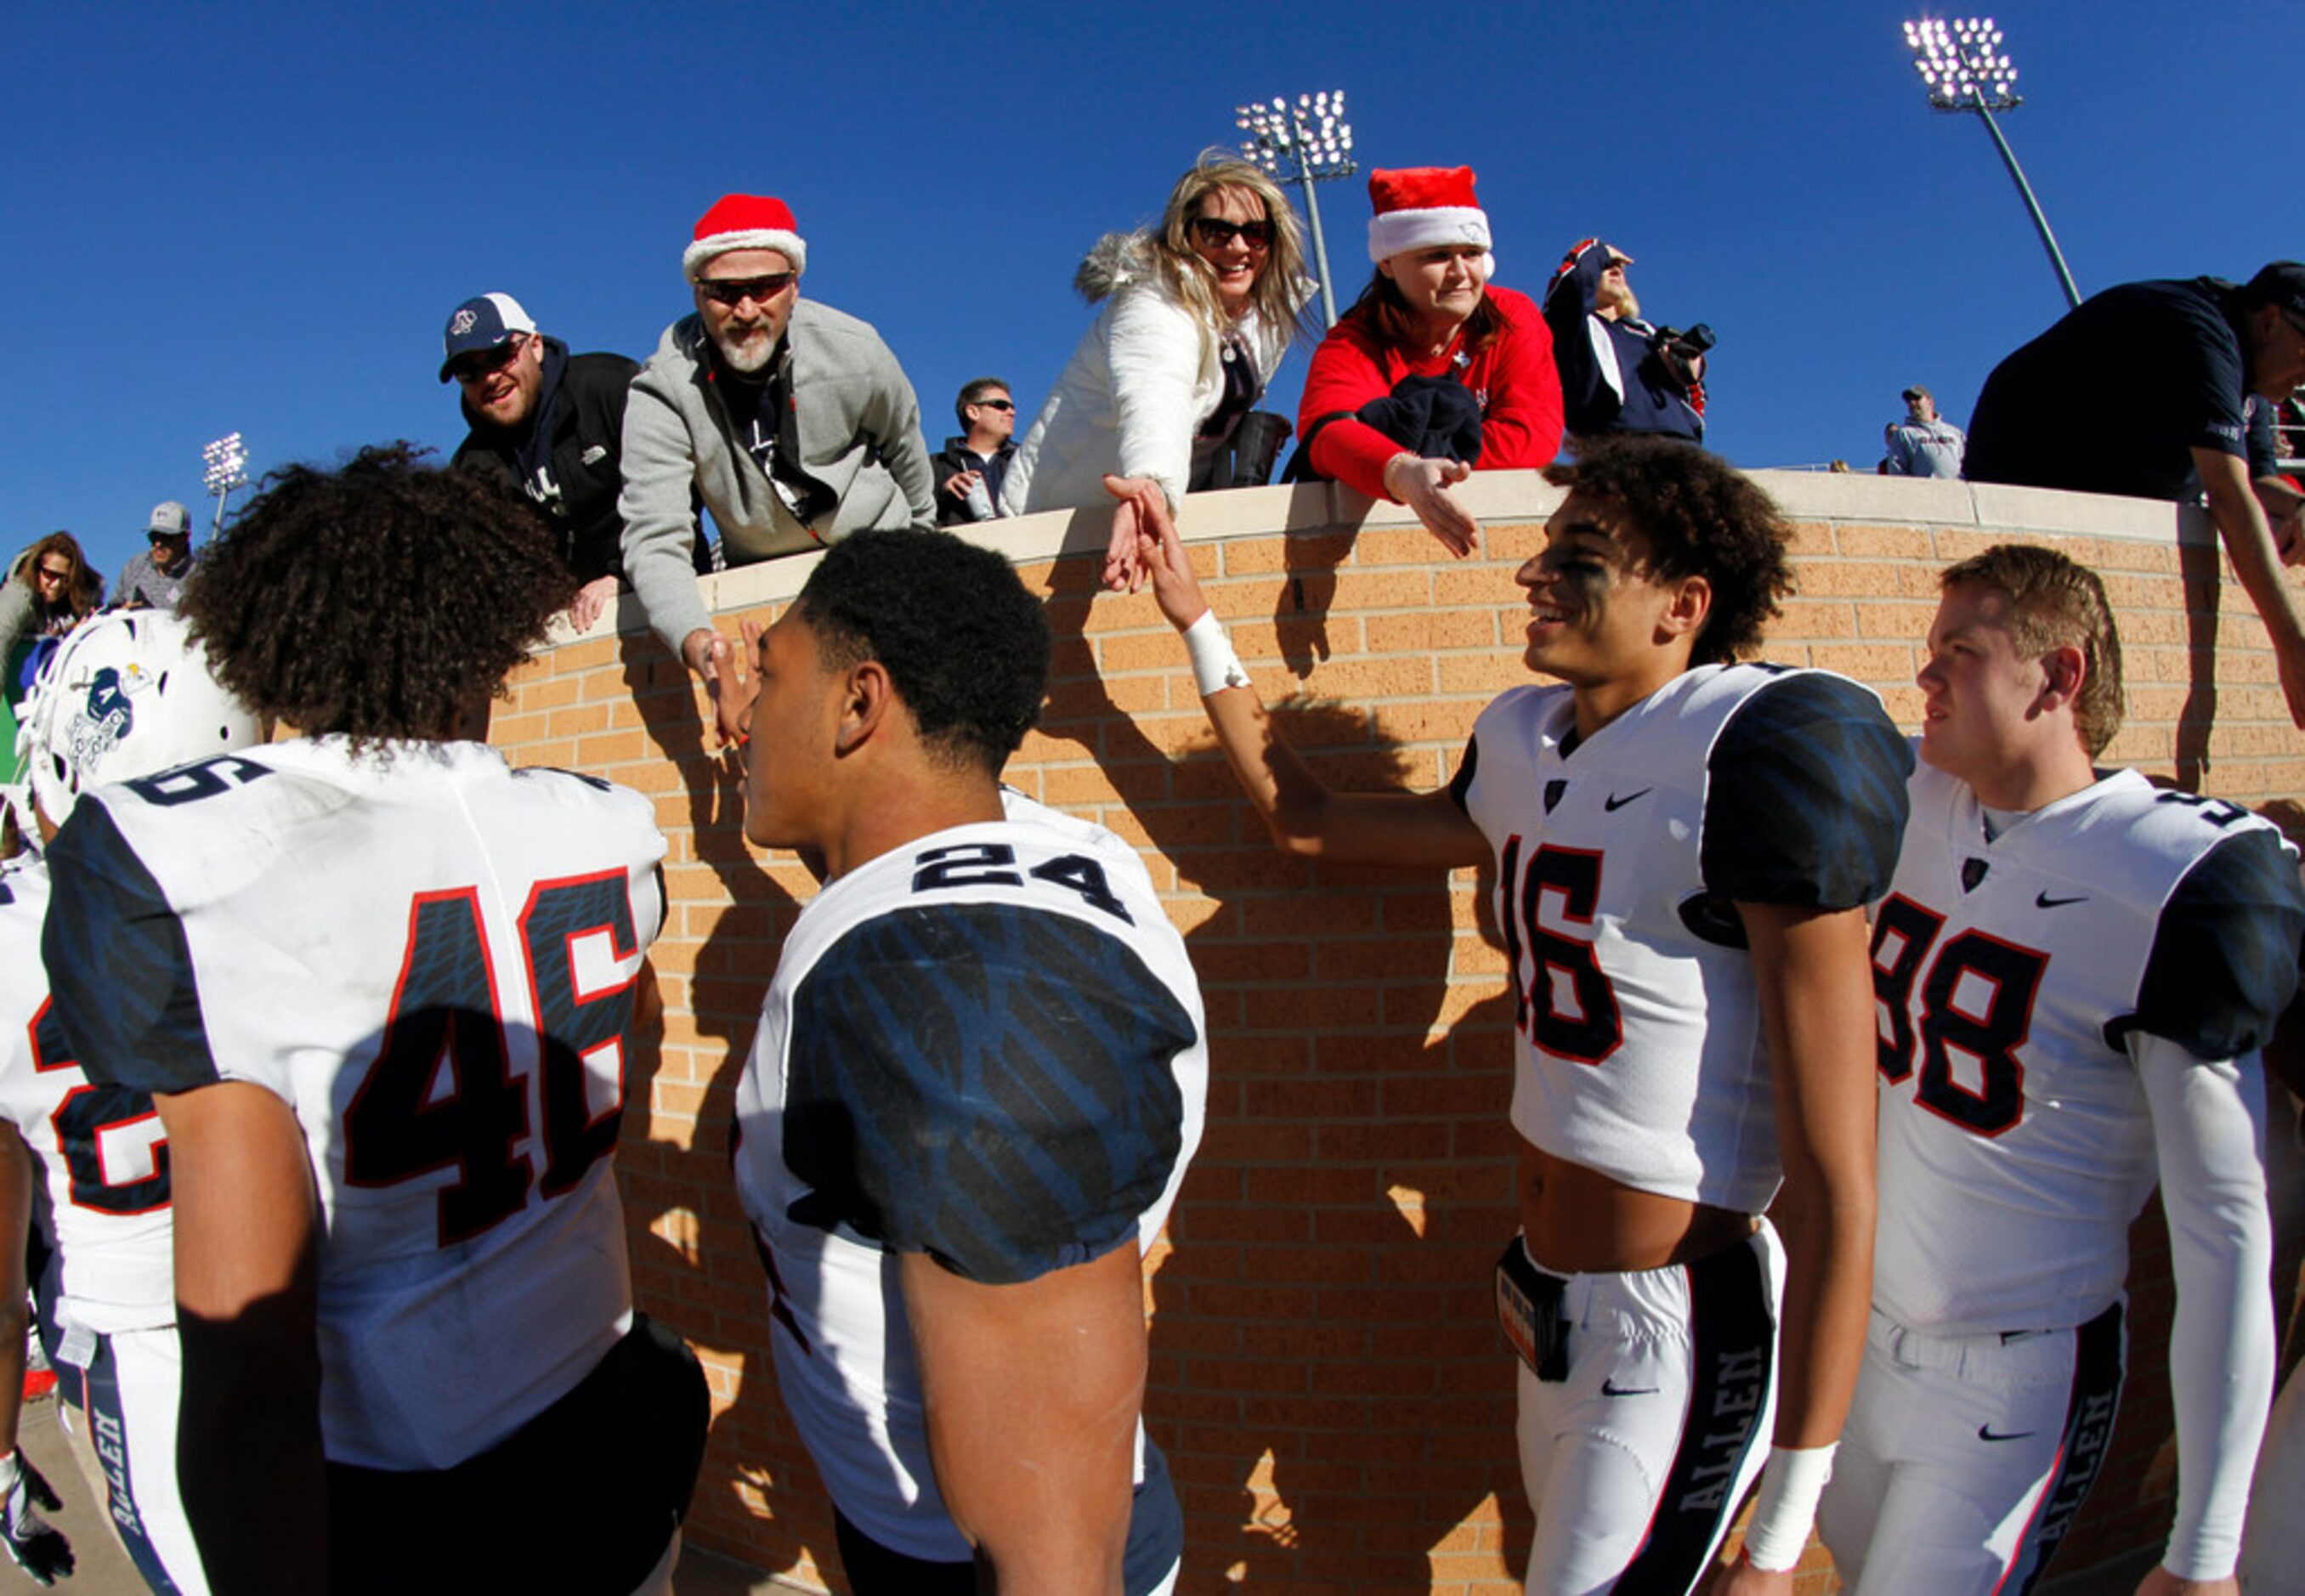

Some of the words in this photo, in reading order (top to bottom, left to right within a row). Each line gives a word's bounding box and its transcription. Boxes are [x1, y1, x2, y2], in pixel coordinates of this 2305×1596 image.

[911, 844, 1136, 928] 24
[343, 865, 639, 1249] 46
[93, 1406, 141, 1537] ALLEN
[1679, 1344, 1763, 1513] ALLEN
[2034, 1390, 2113, 1545] ALLEN
